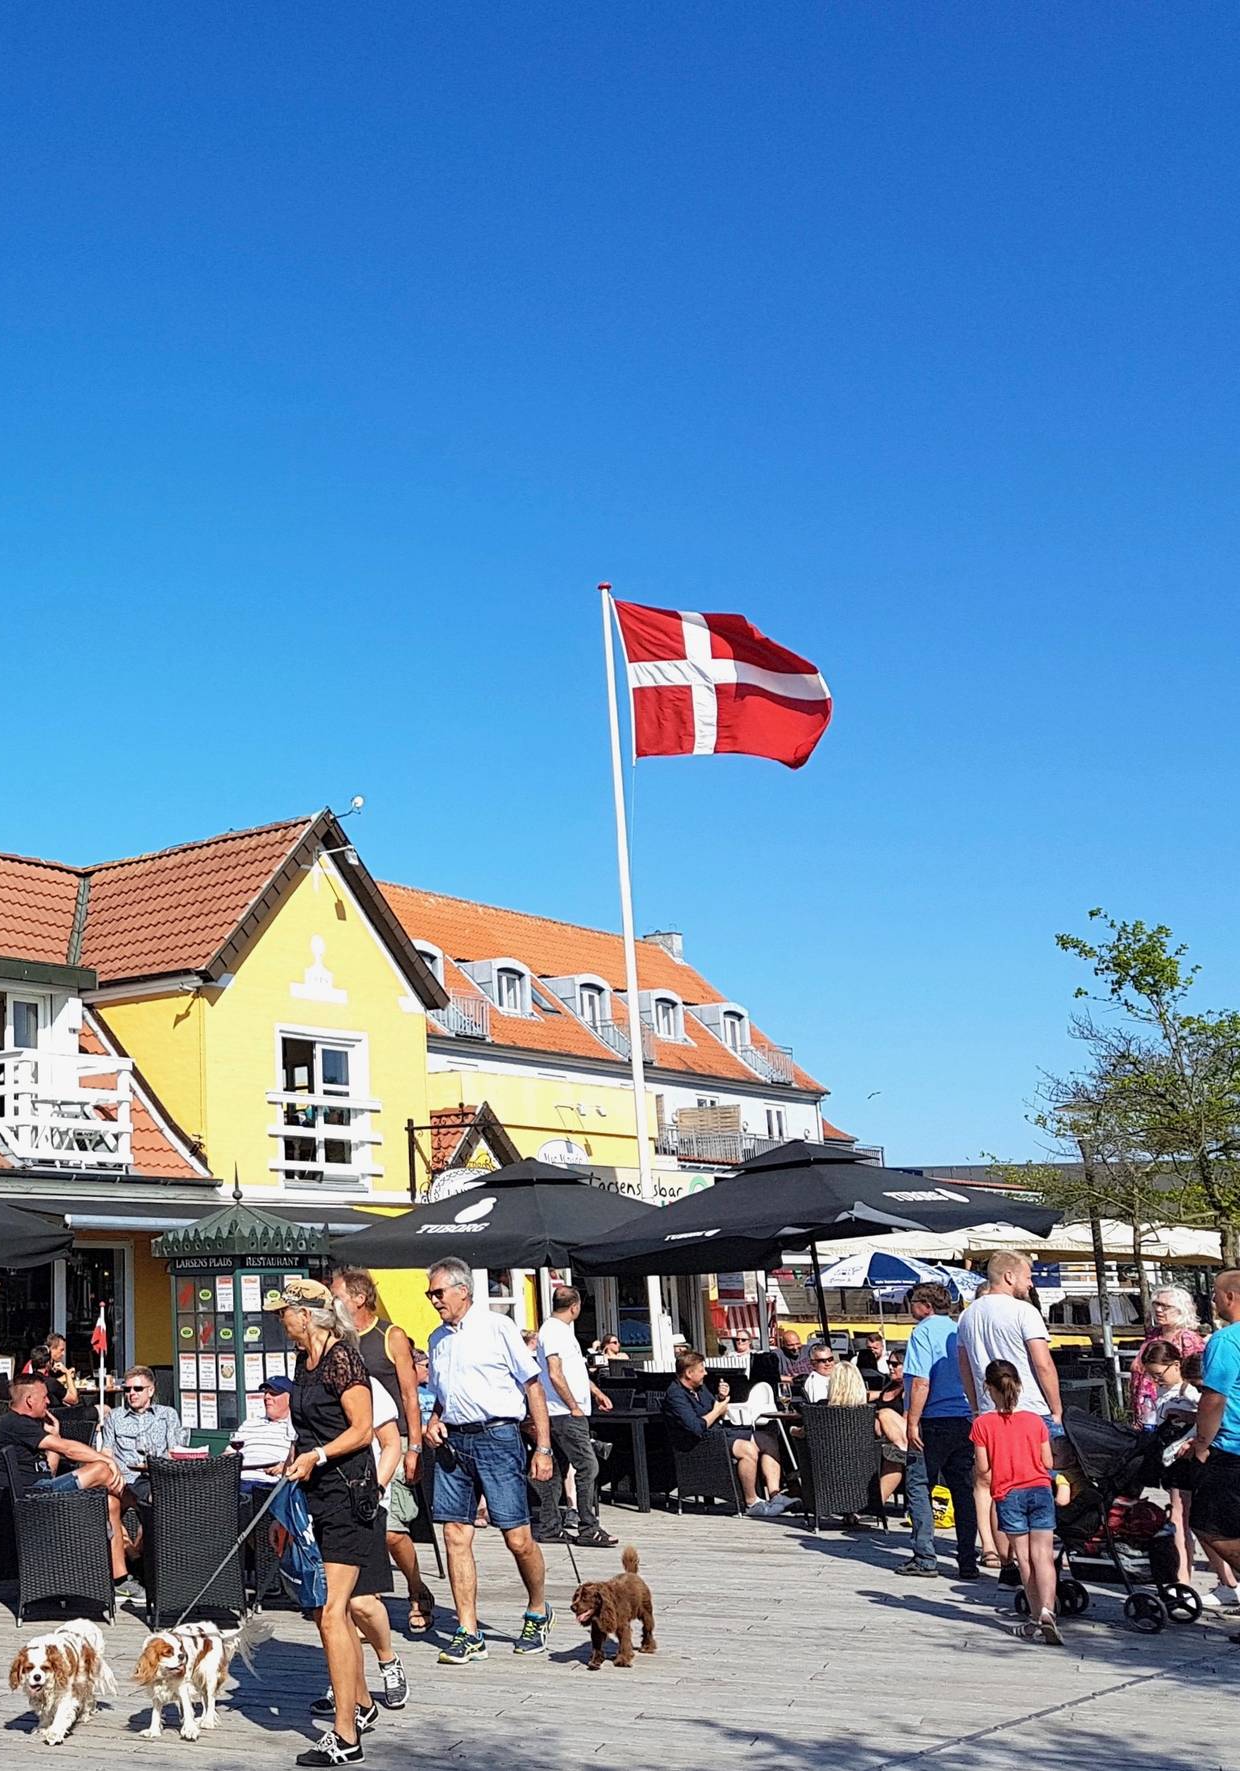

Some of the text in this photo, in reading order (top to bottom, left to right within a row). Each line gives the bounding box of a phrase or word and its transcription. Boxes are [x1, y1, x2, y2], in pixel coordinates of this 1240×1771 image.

[652, 1176, 684, 1198] sbar
[416, 1222, 491, 1234] TUBORG
[175, 1256, 233, 1269] LARSENS PLADS
[245, 1256, 300, 1267] RESTAURANT
